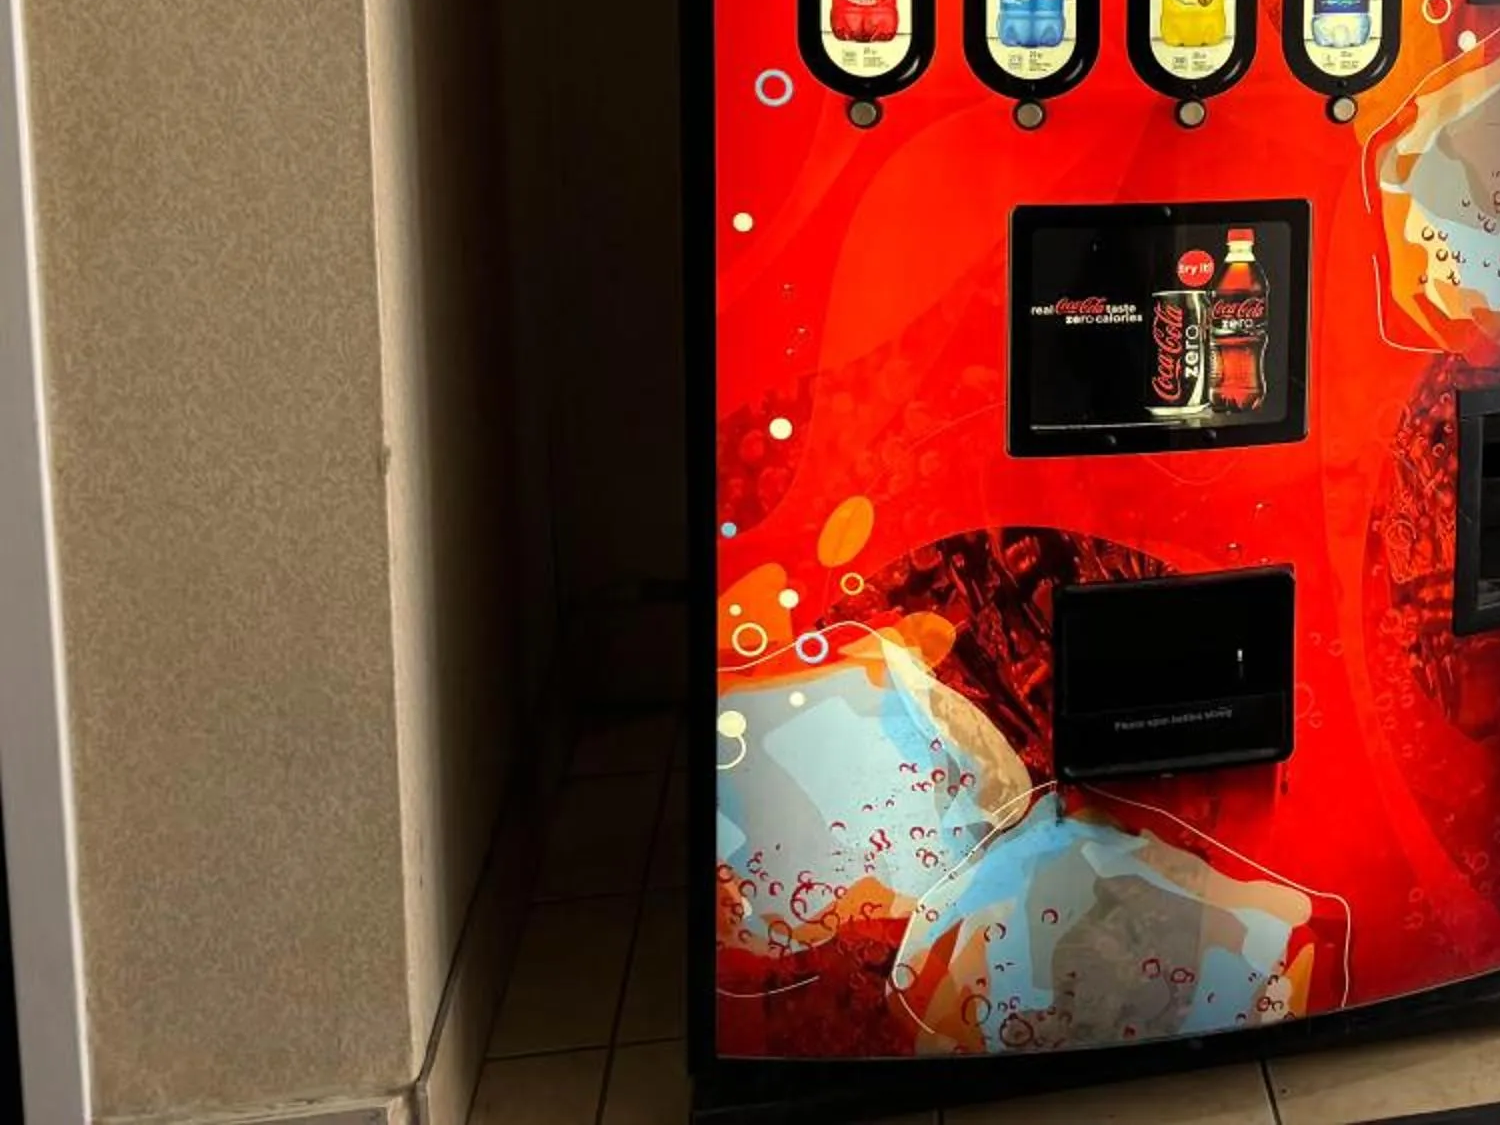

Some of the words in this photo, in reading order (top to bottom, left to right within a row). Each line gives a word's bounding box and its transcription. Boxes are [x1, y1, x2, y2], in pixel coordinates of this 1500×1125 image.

[1030, 305, 1054, 315] real
[1055, 296, 1107, 314] Coca-Cola
[1105, 302, 1137, 313] taste
[1212, 296, 1265, 318] Coca-Cola
[1065, 314, 1094, 324] zero
[1095, 312, 1143, 323] calories
[1221, 317, 1254, 328] zero
[1152, 298, 1183, 401] Coca-Cola
[1184, 324, 1201, 378] zero
